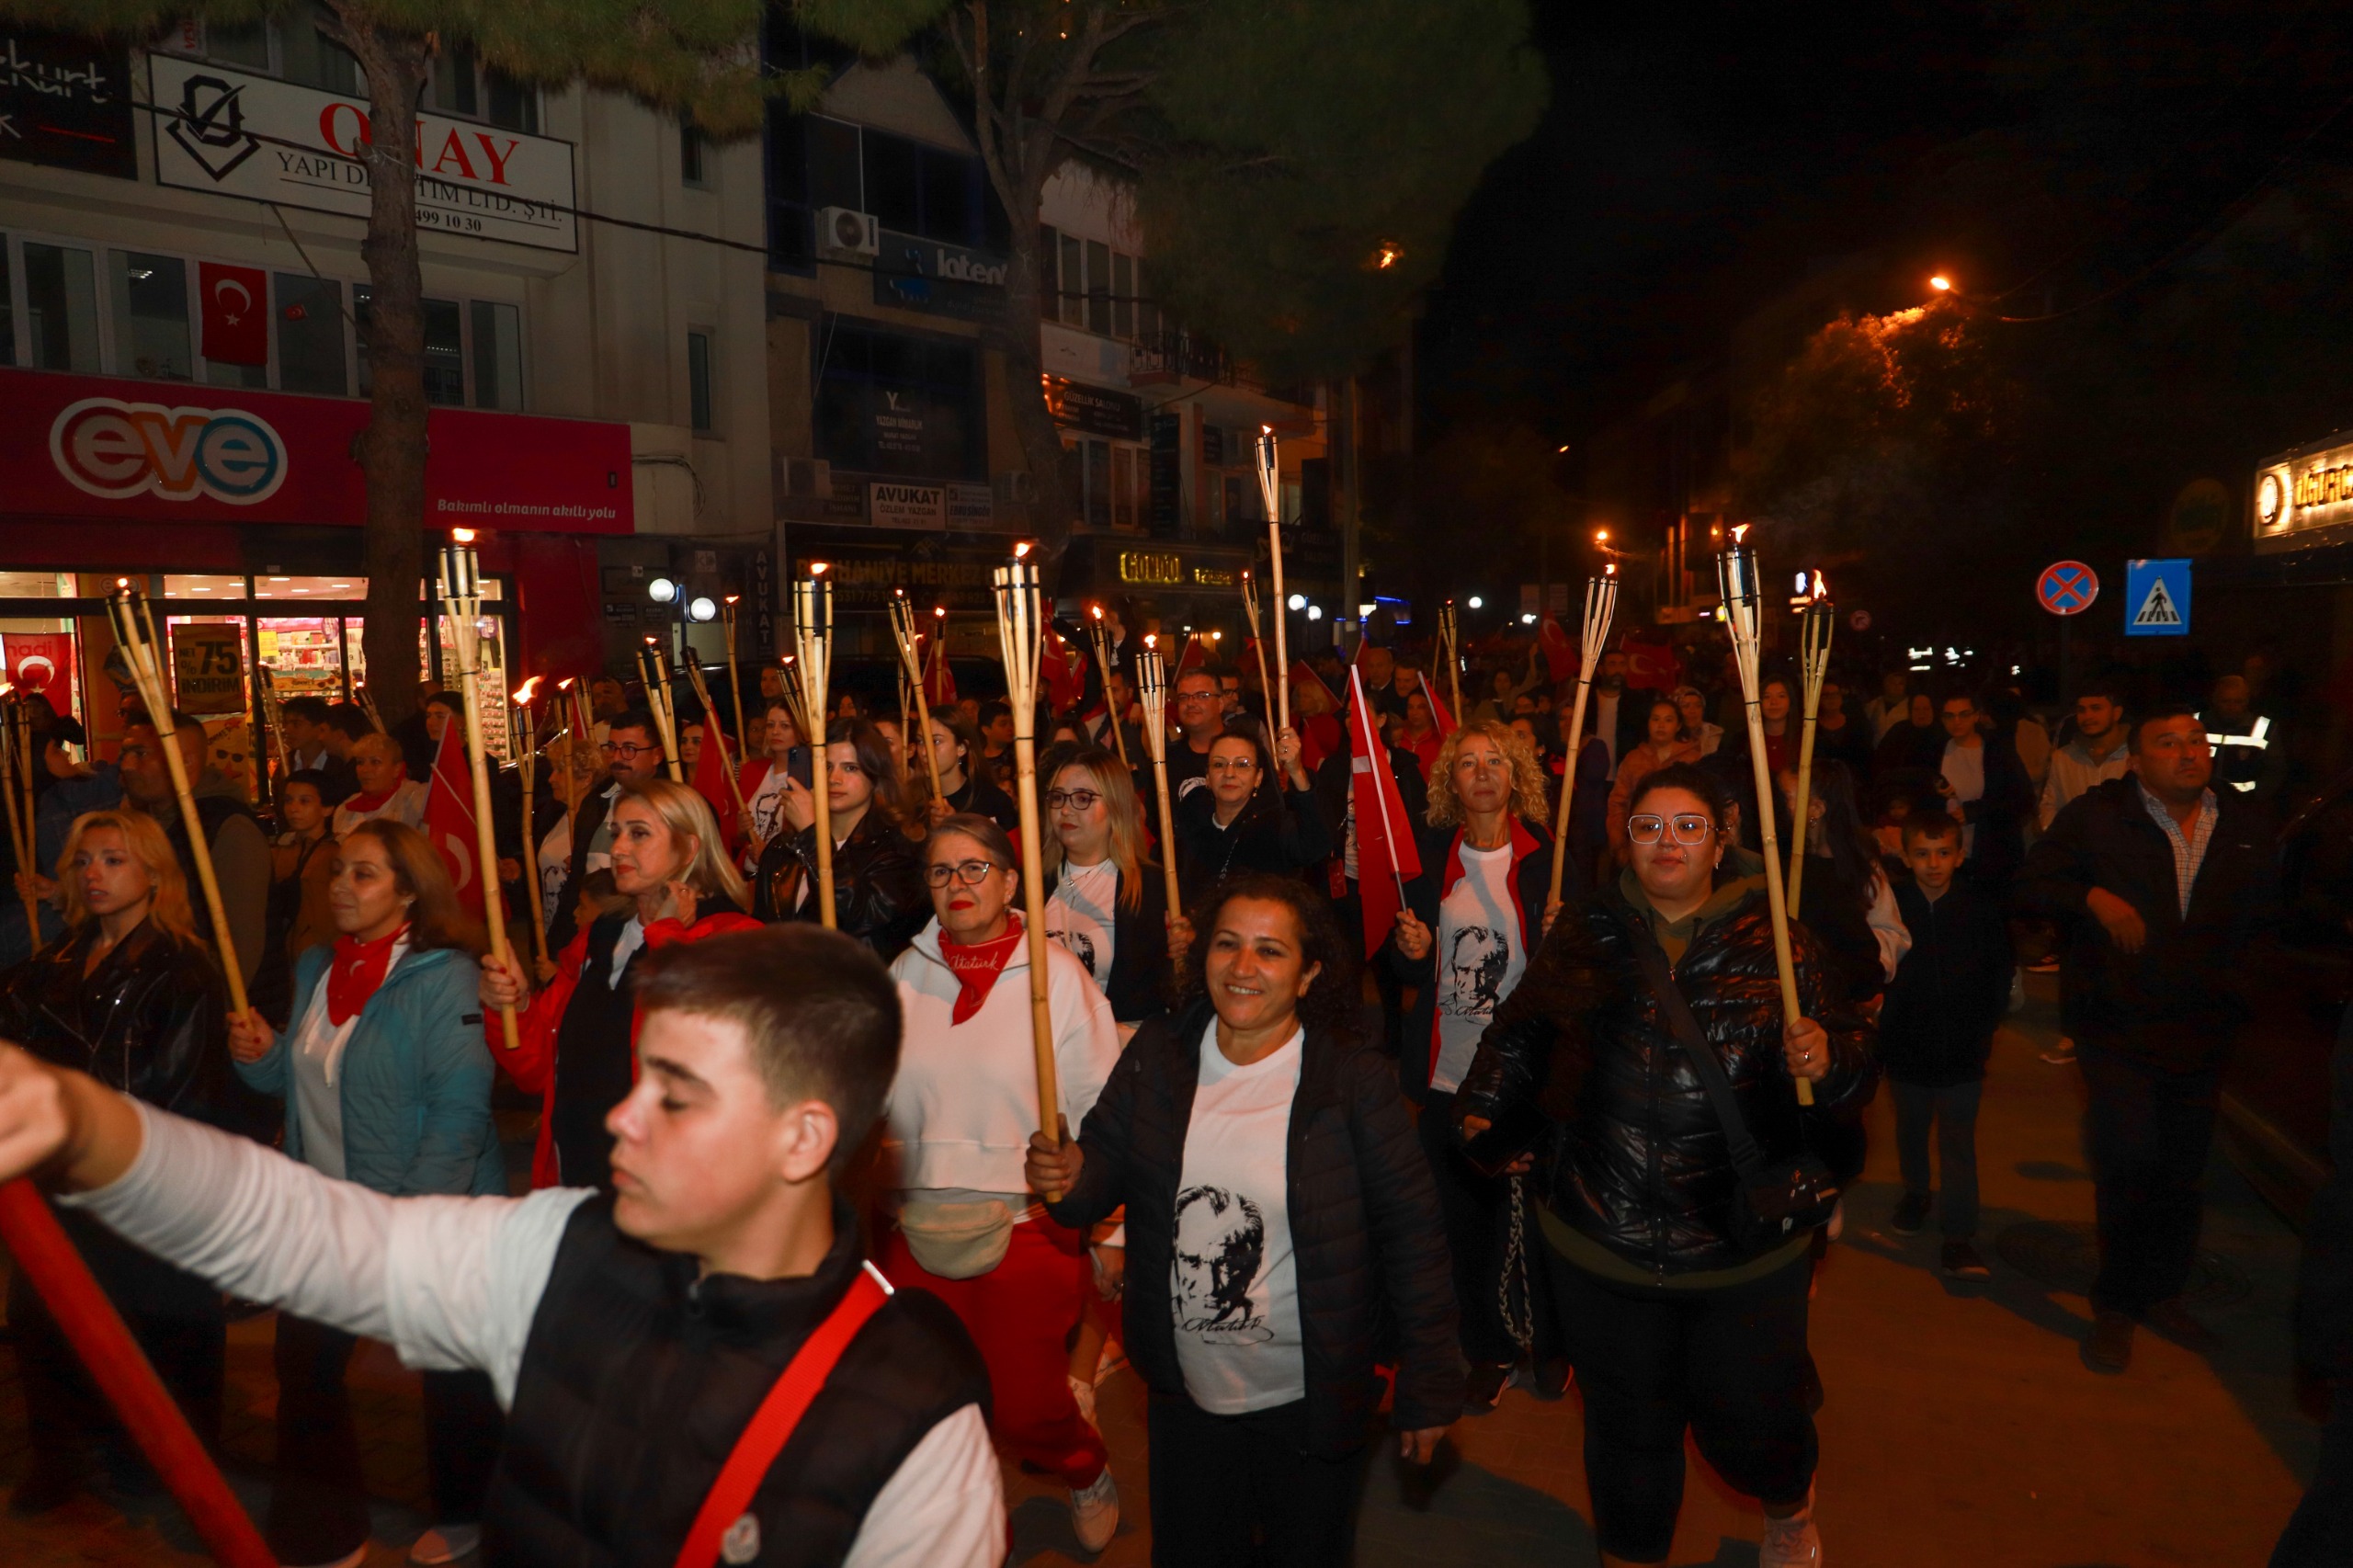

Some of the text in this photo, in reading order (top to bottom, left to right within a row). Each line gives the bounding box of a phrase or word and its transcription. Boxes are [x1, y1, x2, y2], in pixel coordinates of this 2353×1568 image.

[320, 103, 519, 187] OAY
[278, 152, 336, 182] YAPI
[445, 213, 460, 228] 10
[465, 217, 481, 232] 30
[55, 402, 283, 499] eve
[876, 486, 939, 505] AVUKAT
[438, 498, 617, 521] Bakımlı olmanın akıllı yolu
[880, 504, 937, 517] ÖZLEM YAZGAN
[911, 562, 982, 585] MERKEZ
[756, 551, 772, 644] AVUKAT
[178, 647, 197, 657] NET
[180, 641, 239, 676] % 75
